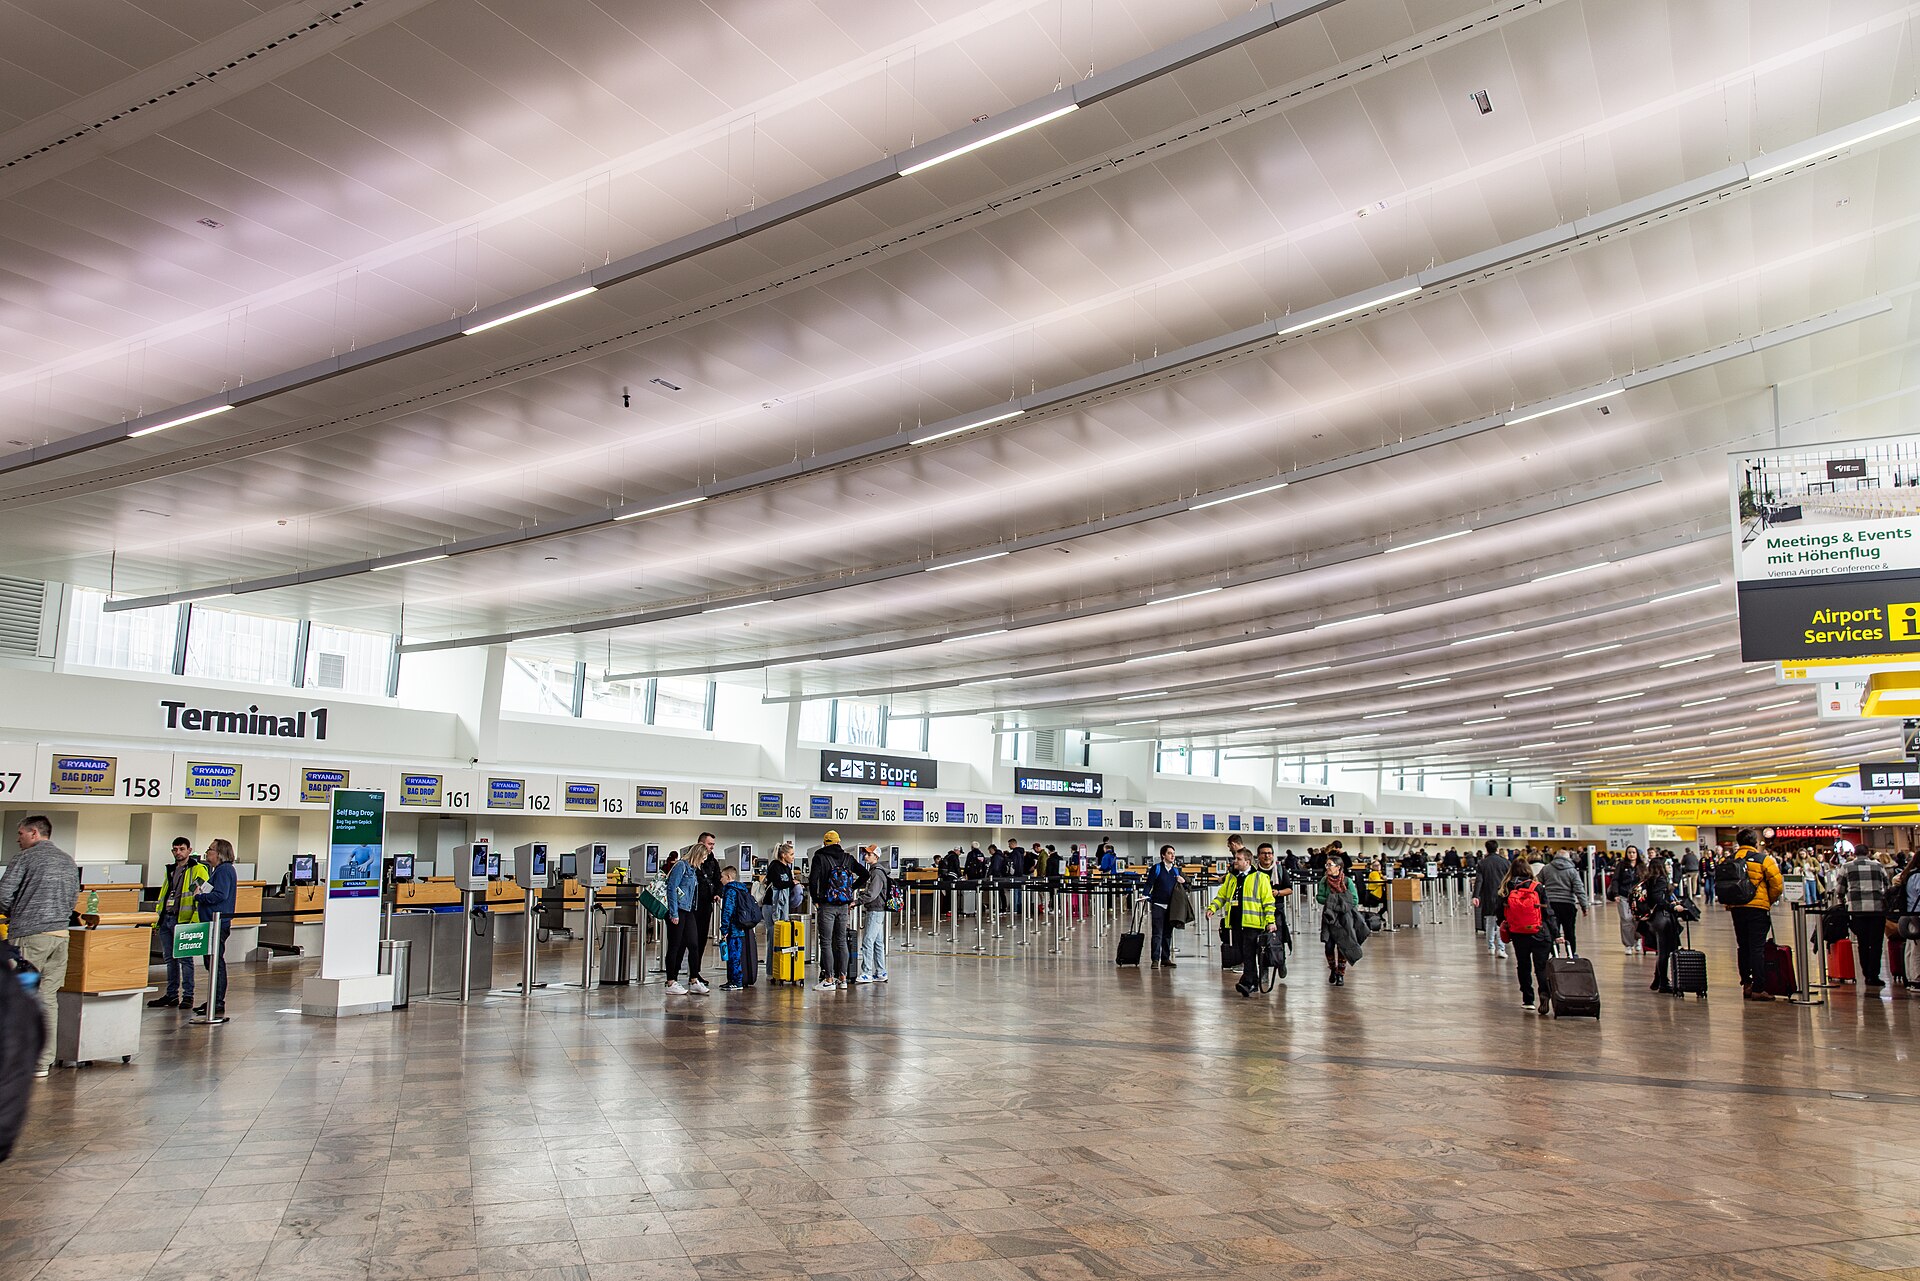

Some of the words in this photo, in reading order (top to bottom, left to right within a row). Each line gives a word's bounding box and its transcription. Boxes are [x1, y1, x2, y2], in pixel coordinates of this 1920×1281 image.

[1767, 534, 1838, 549] Meetings
[1842, 532, 1853, 542] &
[1858, 528, 1912, 542] Events
[1768, 552, 1794, 564] mit
[1798, 546, 1880, 562] Höhenflug
[1798, 567, 1829, 577] Airport
[1832, 564, 1879, 574] Conference
[1812, 607, 1882, 627] Airport
[1804, 627, 1883, 643] Services
[160, 700, 306, 739] Terminal
[310, 708, 328, 740] 1
[66, 761, 107, 769] RYANAIR
[199, 767, 234, 775] RYANAIR
[869, 766, 876, 780] 3
[62, 772, 79, 782] BAG
[81, 773, 105, 782] DROP
[195, 778, 210, 787] BAG
[211, 779, 232, 787] DROP
[122, 777, 161, 798] 158
[247, 783, 281, 801] 159
[308, 784, 322, 792] BAG
[407, 787, 419, 795] BAG
[446, 791, 470, 807] 161
[528, 795, 550, 811] 162
[1299, 794, 1330, 807] Terminal
[1330, 794, 1335, 807] 1
[602, 798, 623, 812] 163
[669, 801, 689, 814] 164
[730, 803, 748, 817] 165
[348, 809, 359, 817] Bag
[360, 809, 374, 817] Drop
[785, 806, 801, 818] 166
[834, 808, 849, 820] 167
[881, 810, 896, 822] 168
[926, 811, 939, 823] 169
[1658, 808, 1695, 817] flypgs.com
[966, 813, 979, 824] 170
[1004, 814, 1015, 825] 171
[1039, 815, 1049, 826] 172
[1072, 817, 1082, 827] 173
[1104, 818, 1113, 827] 174
[1134, 819, 1143, 829] 175
[1163, 820, 1171, 829] 176
[1190, 821, 1198, 830] 177
[1776, 829, 1813, 837] BURGER
[1815, 829, 1839, 837] KING
[179, 931, 204, 940] Eingang
[178, 942, 202, 950] Entrance
